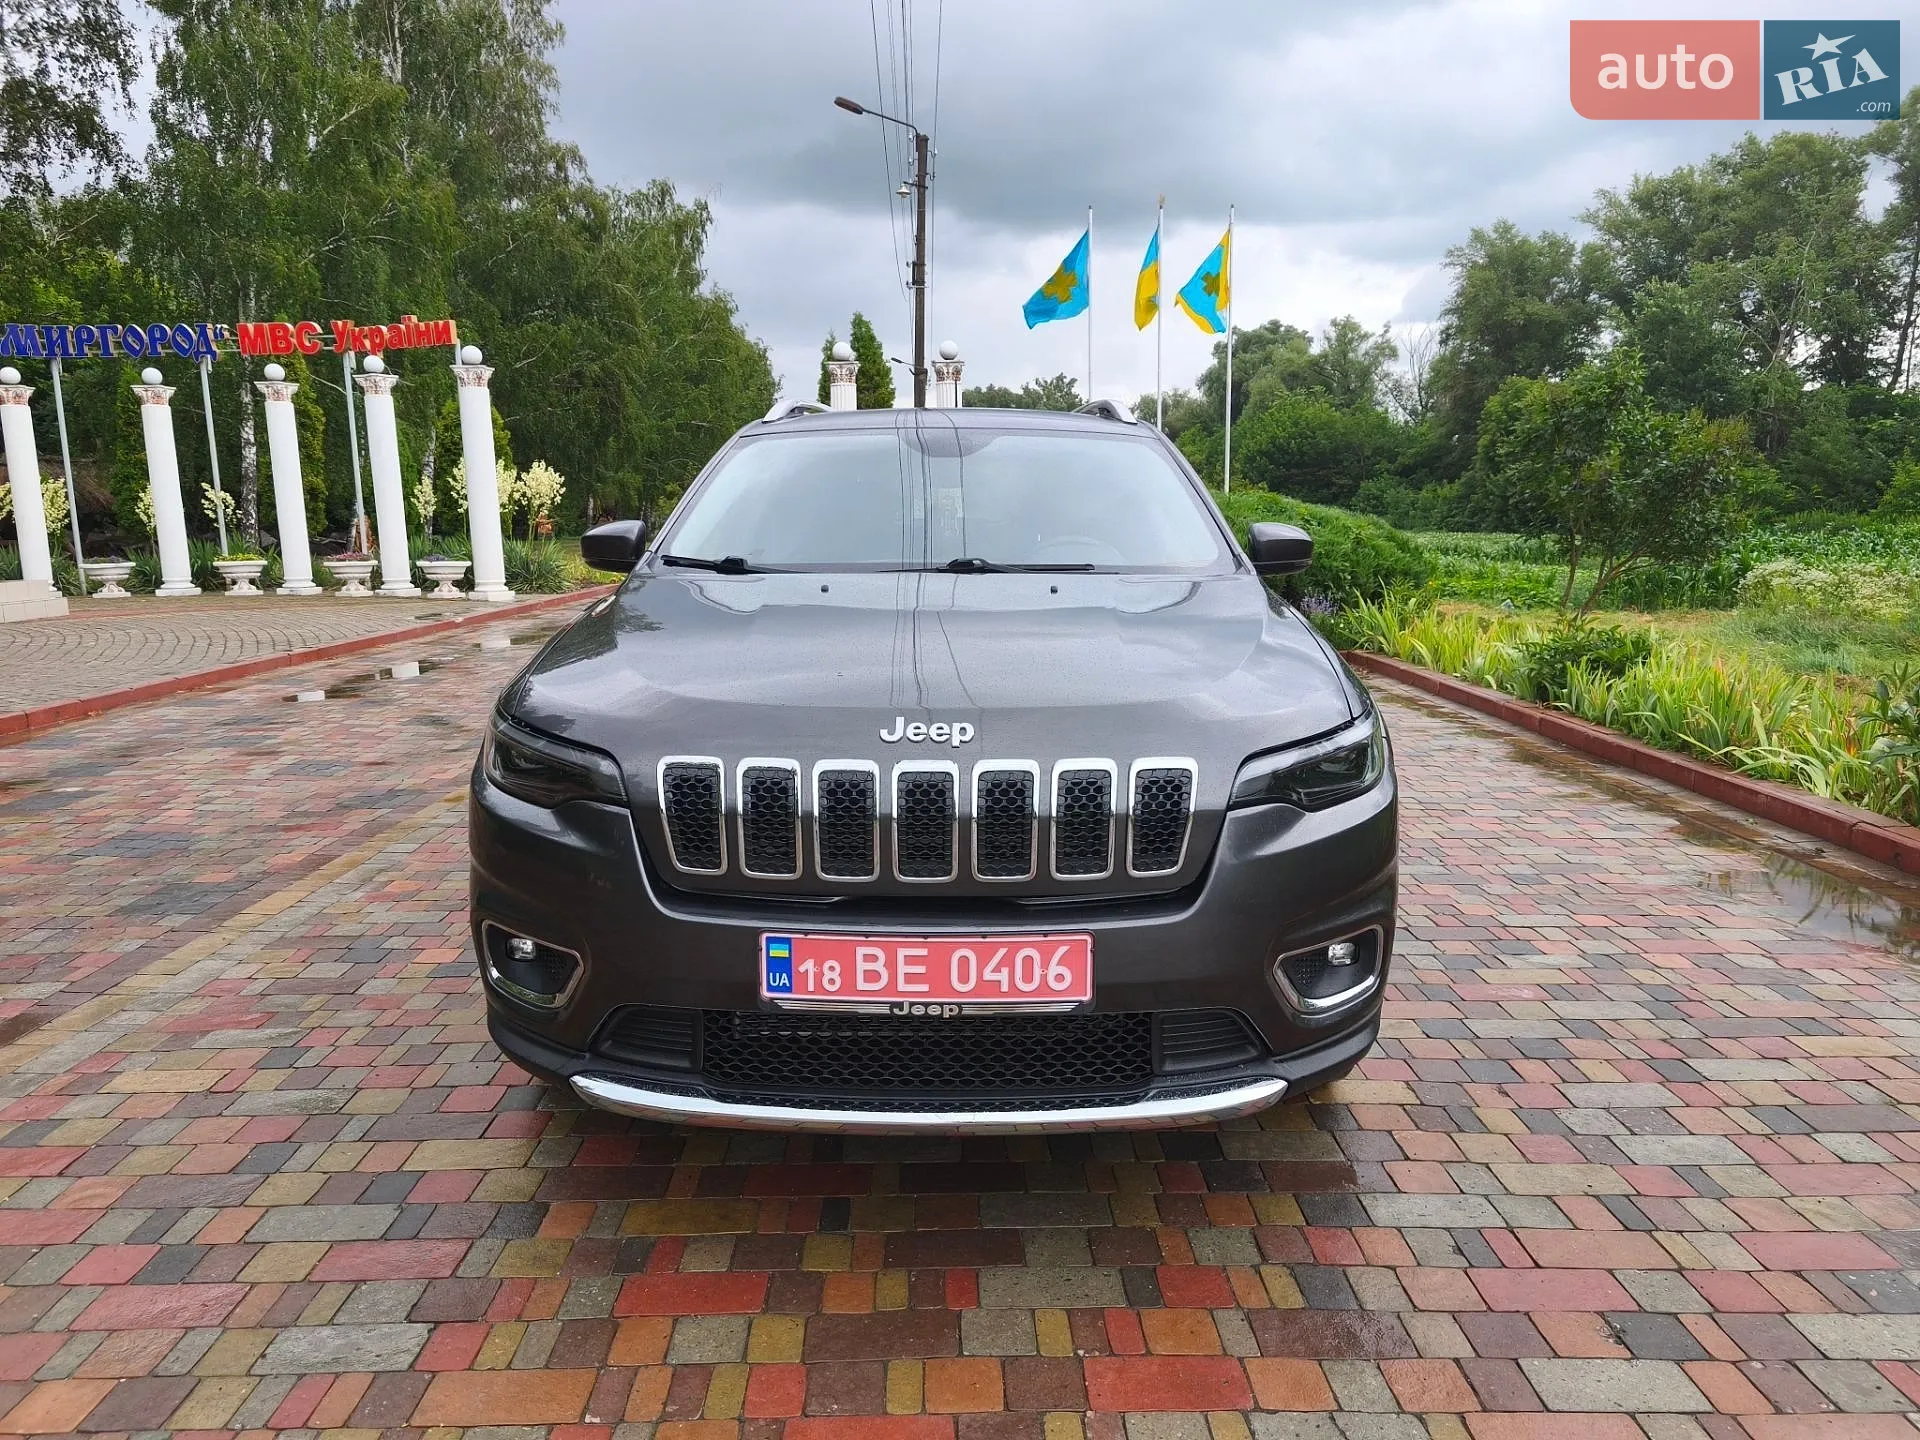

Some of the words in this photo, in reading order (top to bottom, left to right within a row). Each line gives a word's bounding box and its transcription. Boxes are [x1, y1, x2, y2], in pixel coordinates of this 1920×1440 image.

[236, 320, 323, 357] МВС
[330, 314, 457, 358] України
[880, 716, 975, 748] Jeep
[769, 972, 790, 987] UA
[798, 958, 842, 993] 18
[855, 946, 930, 992] BE
[950, 945, 1073, 993] 0406
[892, 1001, 960, 1018] Jeep
